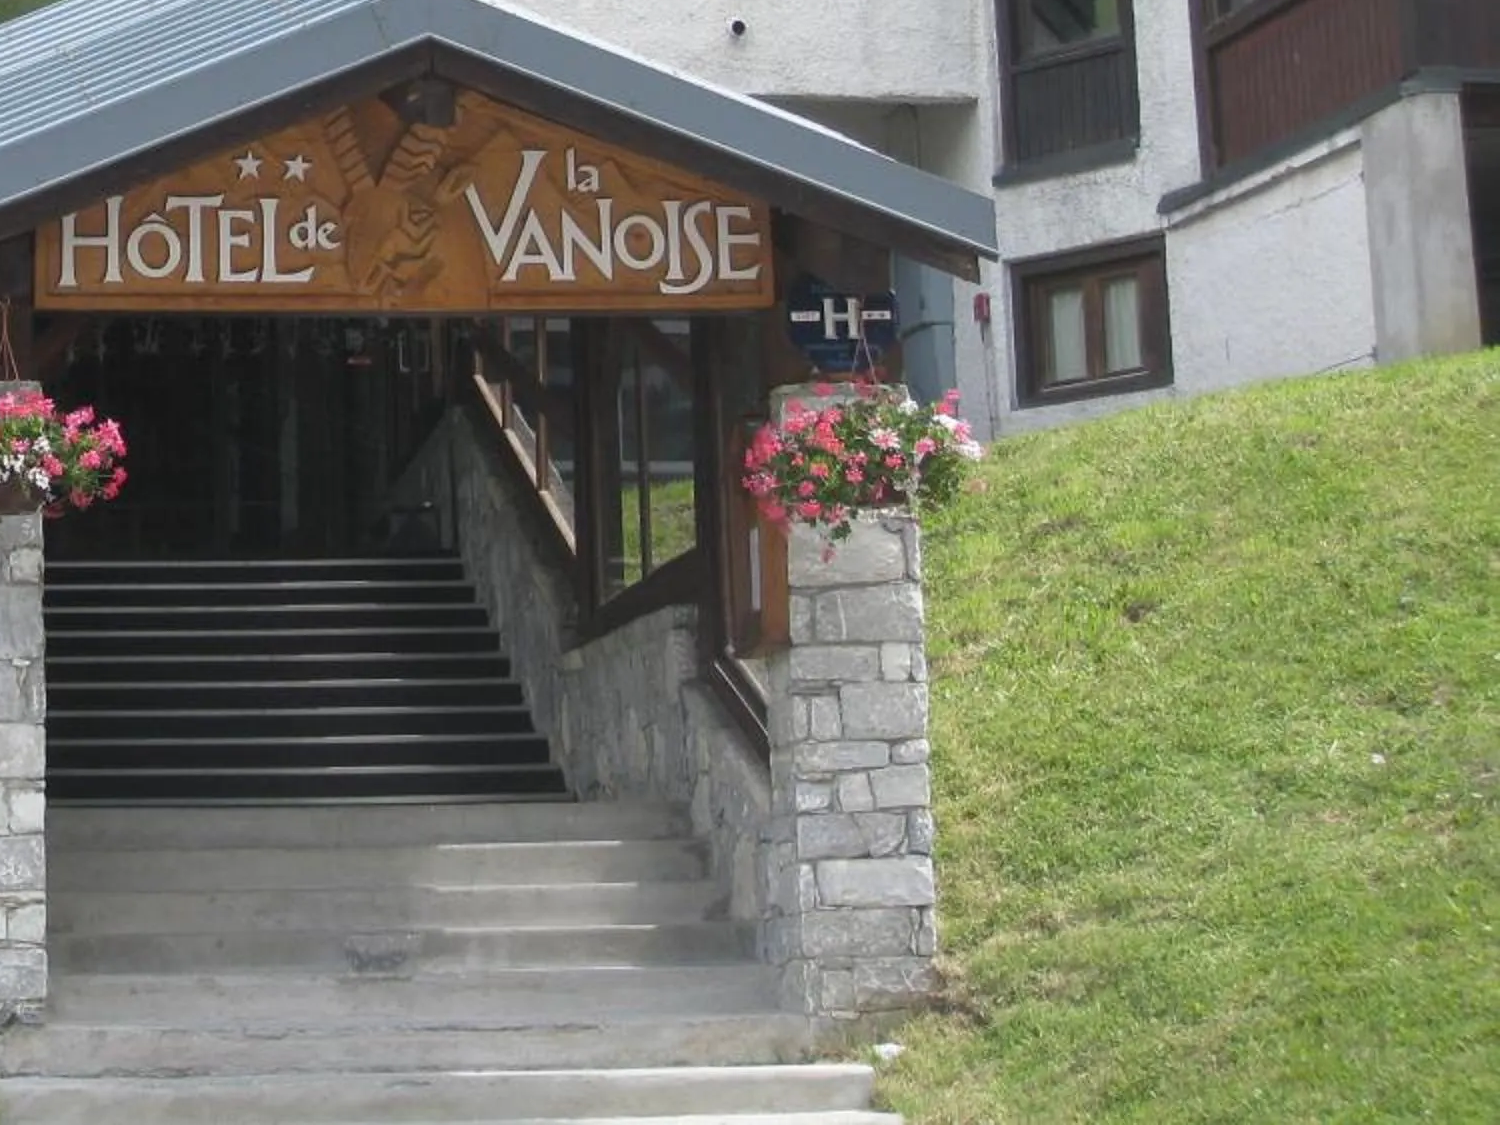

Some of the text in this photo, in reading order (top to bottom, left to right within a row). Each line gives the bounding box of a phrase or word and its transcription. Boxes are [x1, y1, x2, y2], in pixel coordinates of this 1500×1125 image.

[566, 148, 600, 192] la
[289, 205, 340, 250] de
[465, 150, 761, 293] VANOISE
[823, 297, 861, 340] H
